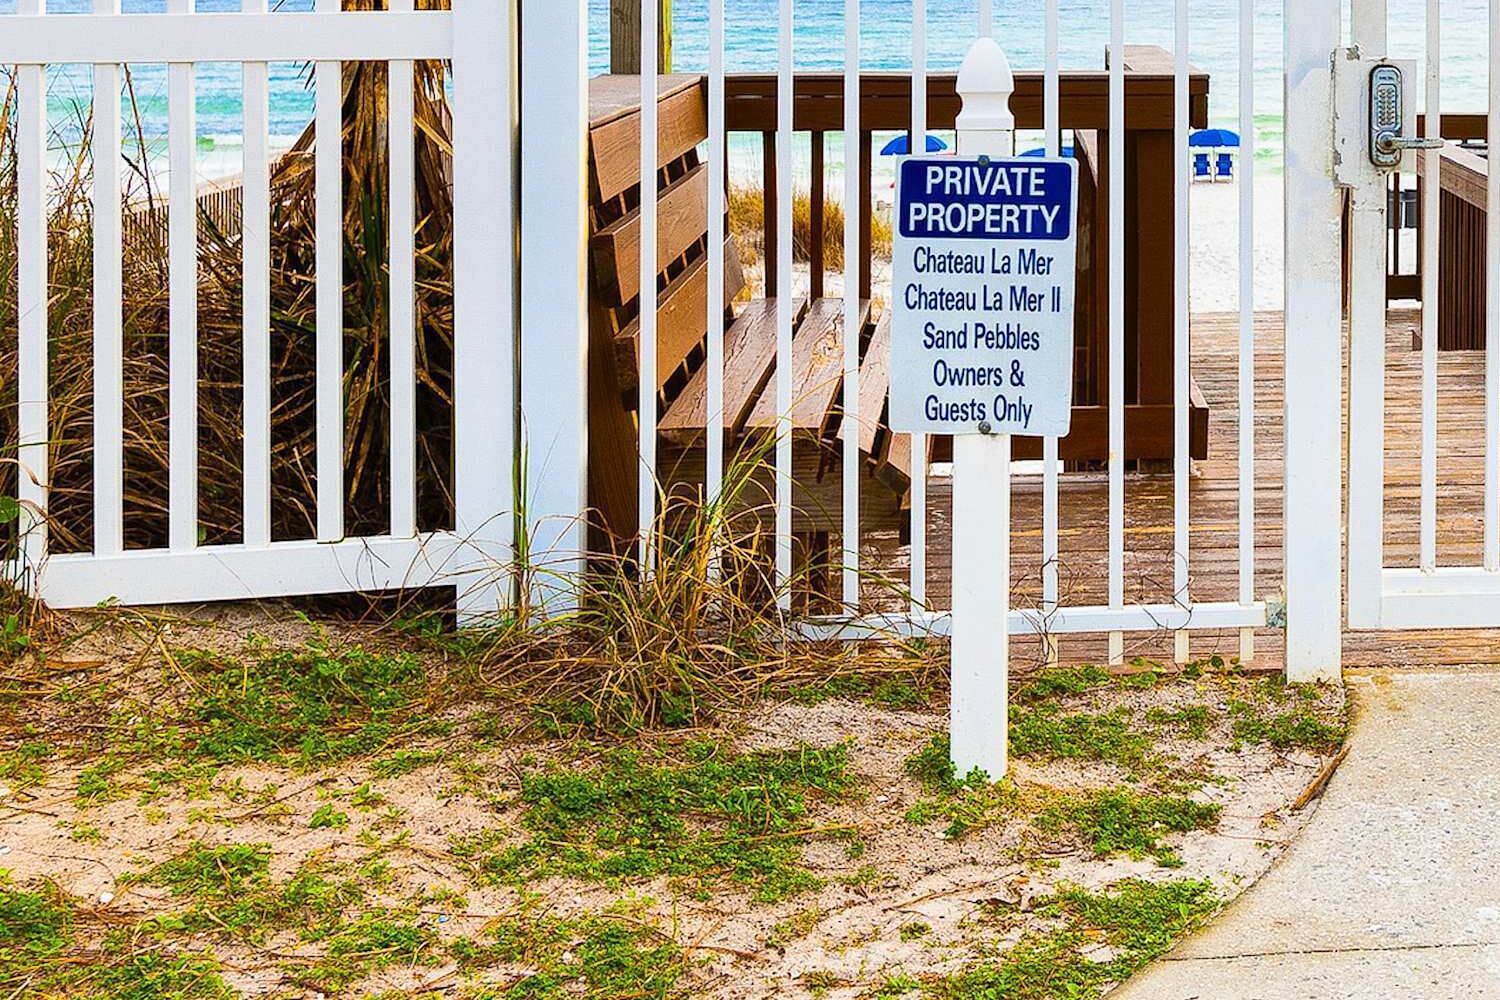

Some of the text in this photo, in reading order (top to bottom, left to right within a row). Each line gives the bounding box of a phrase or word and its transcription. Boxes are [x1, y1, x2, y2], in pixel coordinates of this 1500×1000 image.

[926, 166, 1045, 196] PRIVATE
[909, 202, 1060, 233] PROPERTY
[914, 246, 1053, 276] Chateau La Mer
[905, 283, 1061, 312] Chateau La Mer II
[923, 322, 1040, 351] Sand Pebbles
[934, 359, 1026, 387] Owners &
[925, 394, 1032, 429] Guests Only
